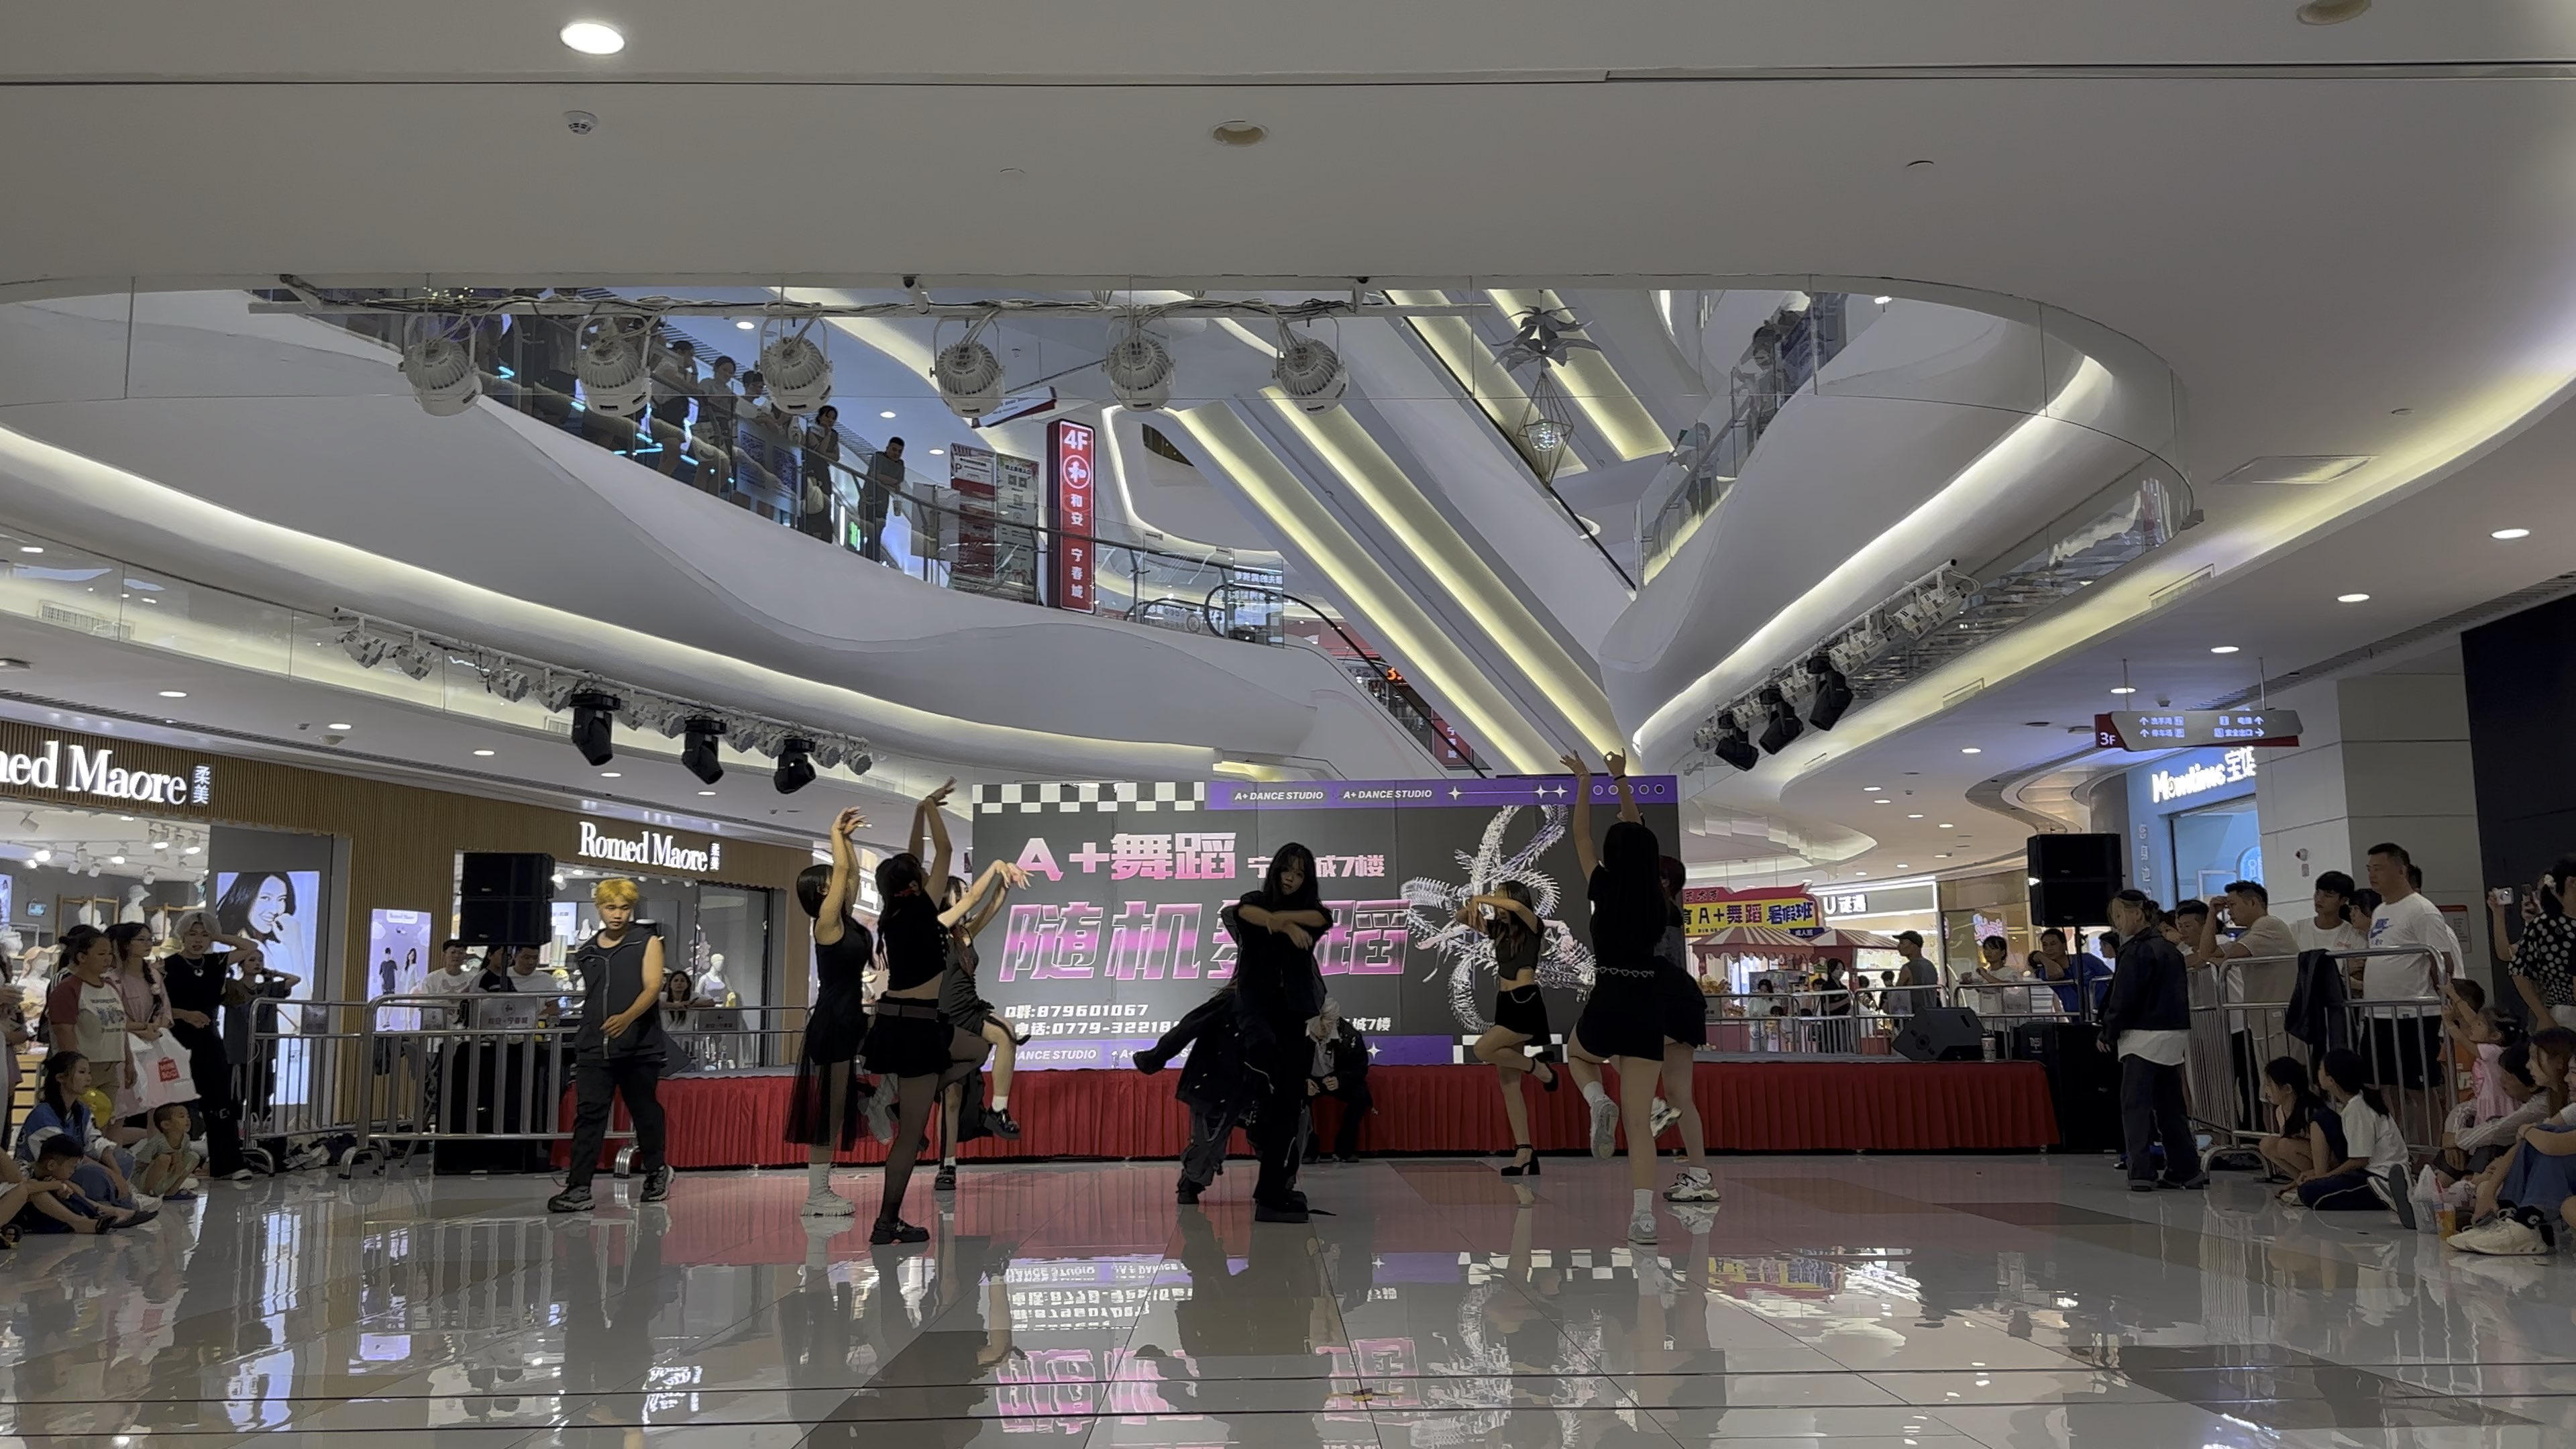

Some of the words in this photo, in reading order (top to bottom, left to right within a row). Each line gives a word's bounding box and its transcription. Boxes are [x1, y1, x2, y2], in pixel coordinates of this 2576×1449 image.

[1064, 430, 1087, 450] 4F
[1071, 548, 1083, 599] 宁春城
[2100, 732, 2116, 745] 3F
[67, 745, 187, 804] Maore
[193, 765, 211, 804] 柔美
[1235, 792, 1248, 800] A+
[1249, 792, 1285, 800] DANCE
[1286, 791, 1324, 800] STUDIO
[1343, 790, 1356, 799] A+
[1358, 790, 1393, 799] DANCE
[1395, 790, 1432, 798] STUDIO
[578, 821, 649, 865] Romed
[651, 833, 708, 872] Maore
[1016, 832, 1236, 882] A+舞蹈
[1766, 902, 1814, 925] 暑假班
[998, 900, 1411, 982] 随机蹈
[1015, 1020, 1179, 1036] 电话:0779-32218
[1016, 1050, 1051, 1060] ANCE
[1053, 1049, 1097, 1060] STUDIO
